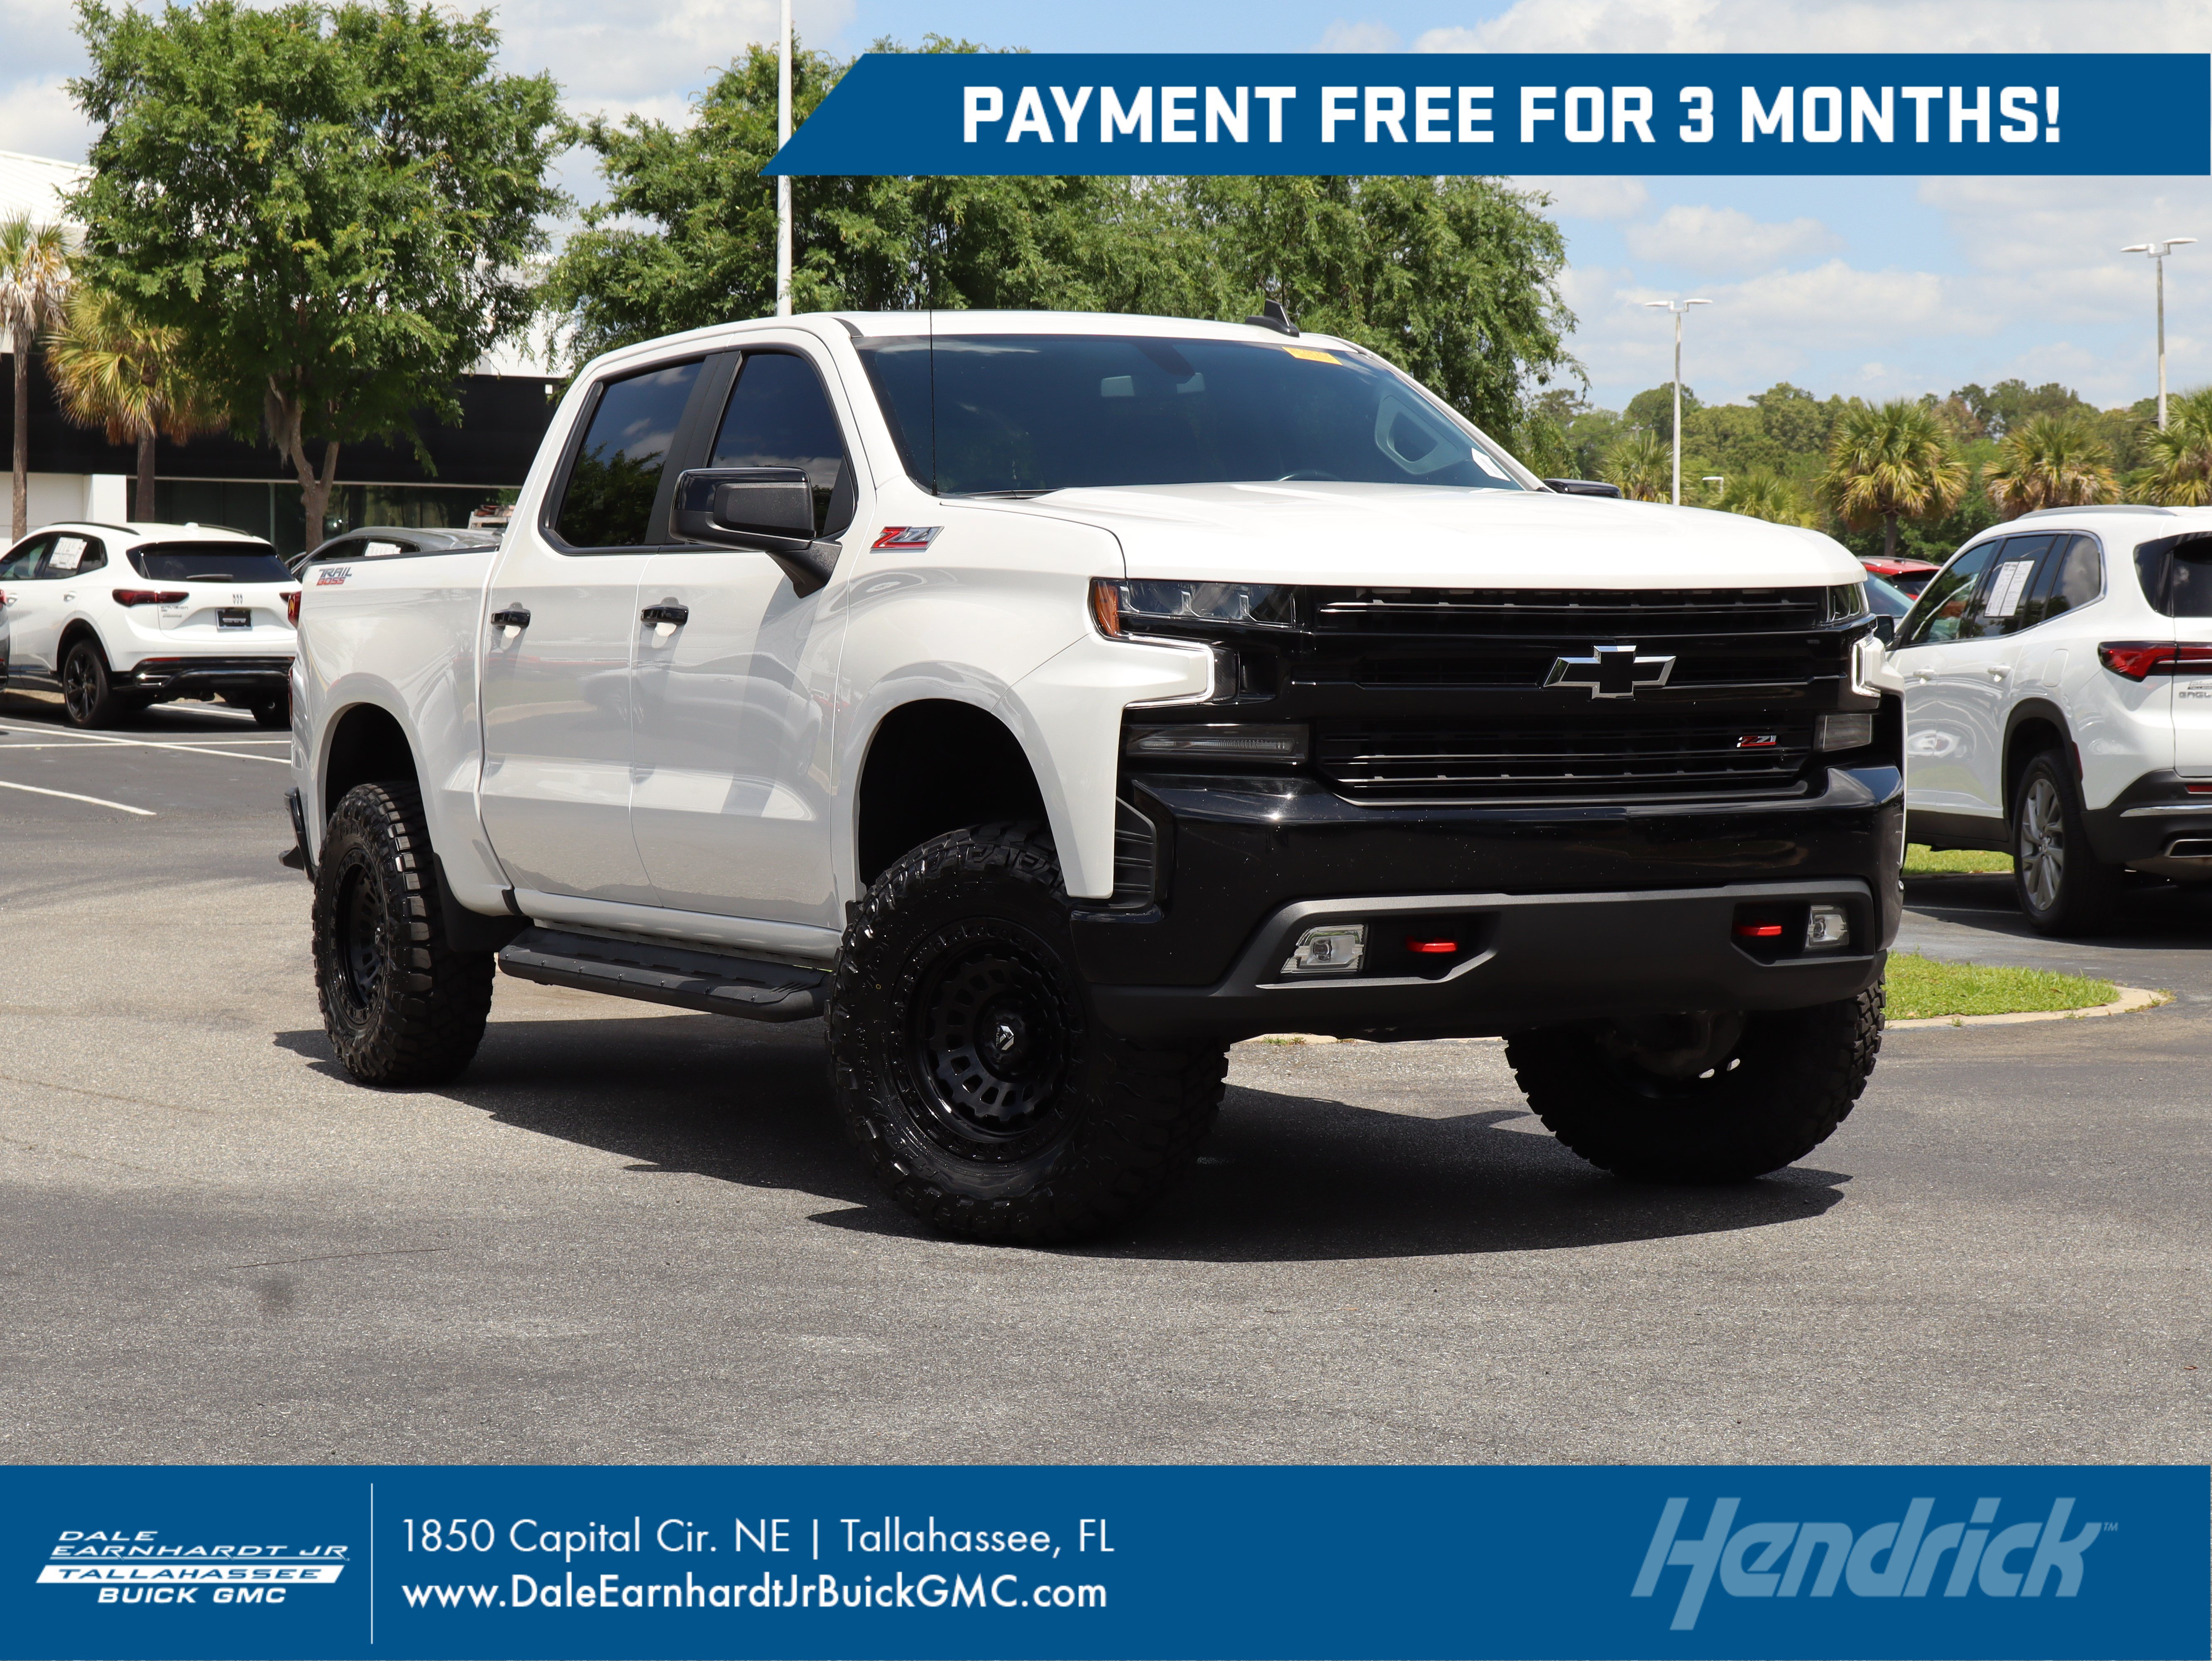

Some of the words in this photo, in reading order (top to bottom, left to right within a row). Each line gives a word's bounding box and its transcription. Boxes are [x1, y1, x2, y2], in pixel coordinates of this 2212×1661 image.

[870, 526, 945, 551] Z71
[319, 567, 352, 578] TRAIL
[316, 577, 346, 586] BOSS
[1737, 735, 1777, 747] Z71
